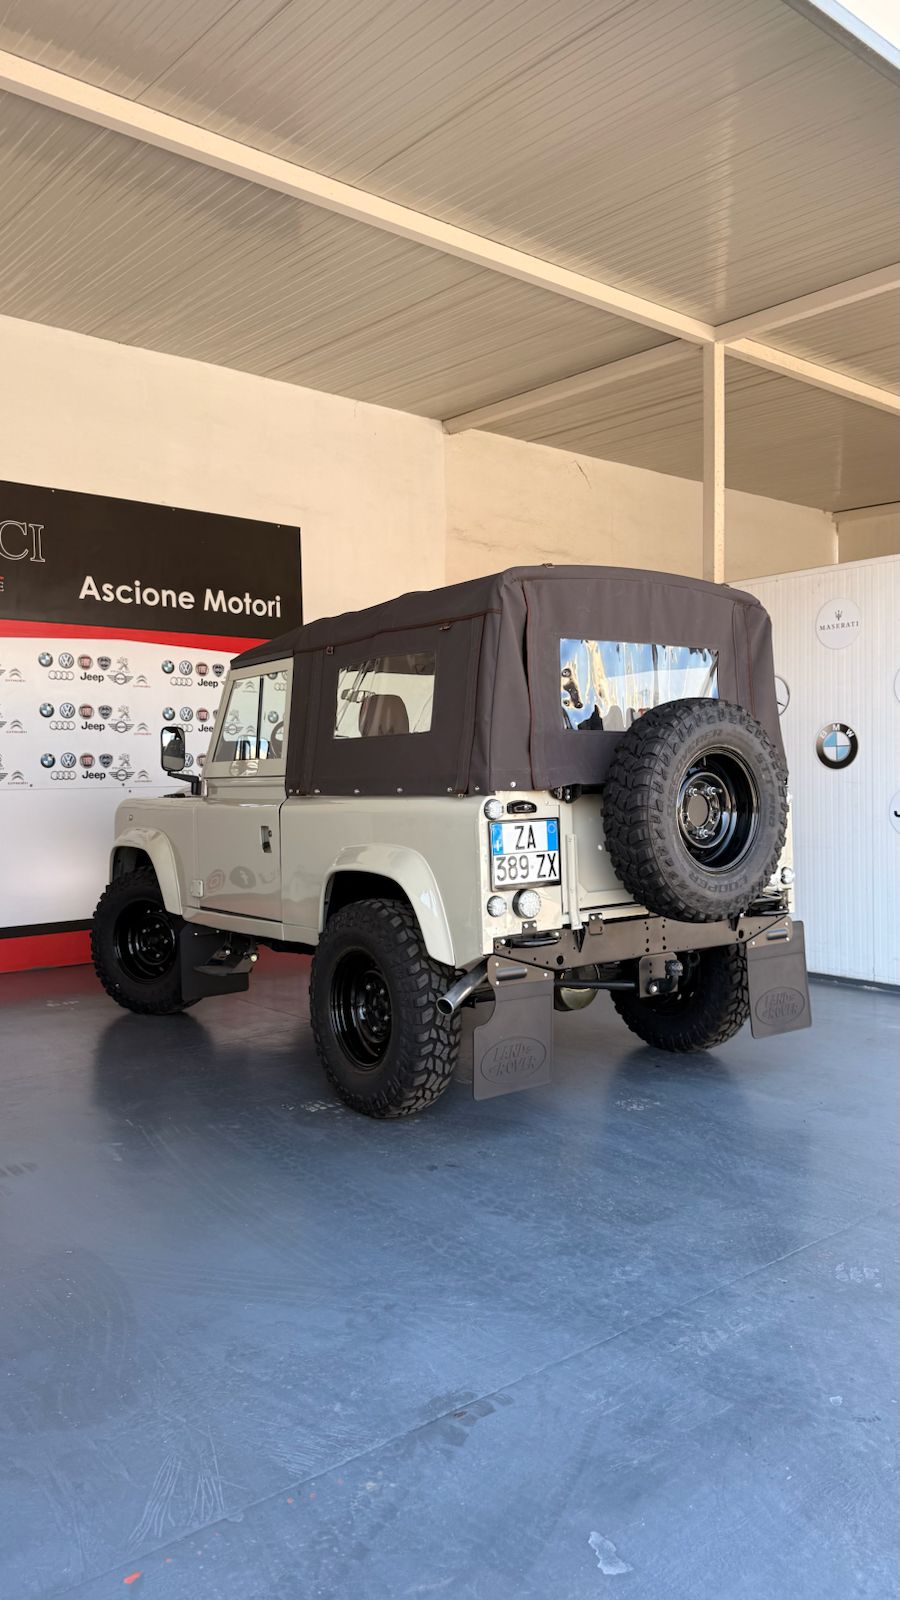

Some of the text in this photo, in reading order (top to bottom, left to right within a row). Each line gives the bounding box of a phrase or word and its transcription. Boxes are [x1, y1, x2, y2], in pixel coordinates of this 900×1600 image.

[78, 575, 281, 618] Ascione Motori
[819, 620, 859, 631] MASERATI
[80, 672, 105, 683] Jeep
[197, 679, 218, 689] Jeep
[81, 721, 106, 732] Jeep
[198, 724, 214, 733] Jee
[82, 770, 106, 780] Jeep
[514, 825, 537, 850] ZA
[496, 852, 558, 881] 389 ZX
